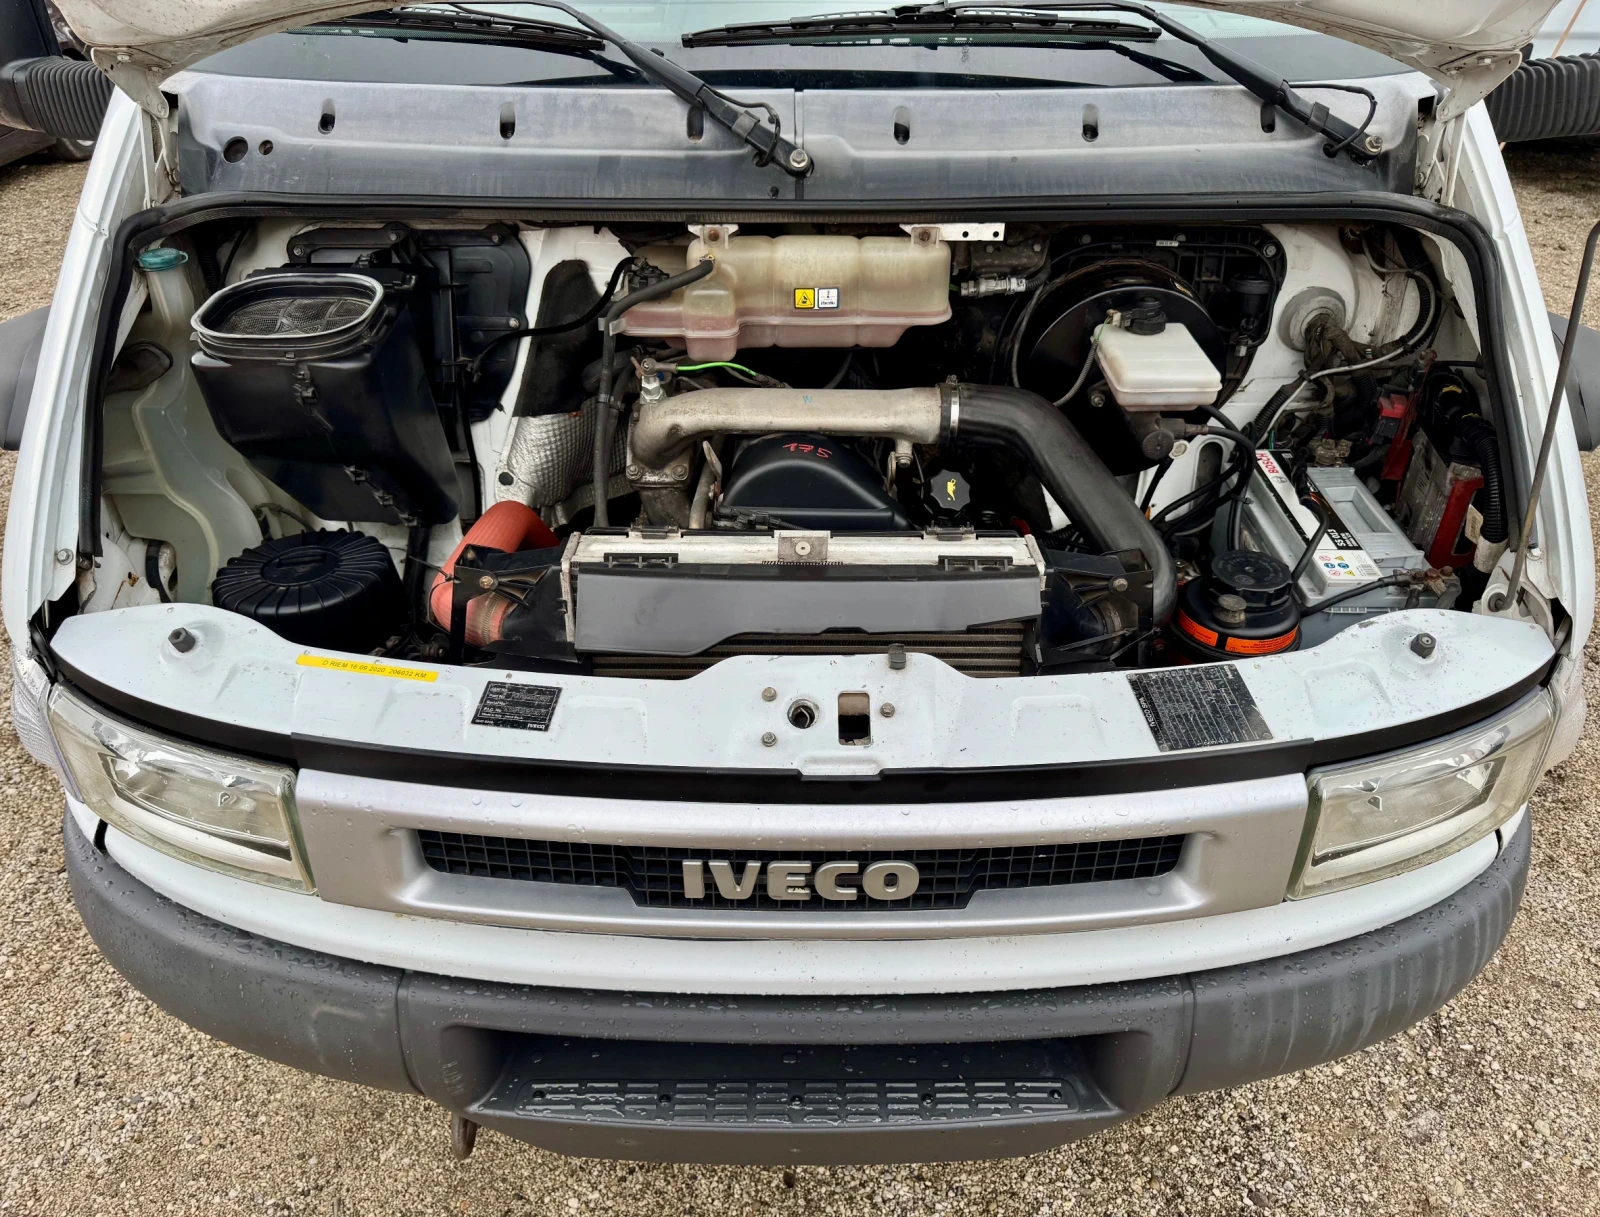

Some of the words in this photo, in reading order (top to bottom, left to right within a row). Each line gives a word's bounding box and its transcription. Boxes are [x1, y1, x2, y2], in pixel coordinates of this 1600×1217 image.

[1256, 453, 1280, 474] BOSCH
[330, 660, 348, 668] RIEM
[368, 665, 386, 673] 2020
[682, 859, 920, 901] IVECO
